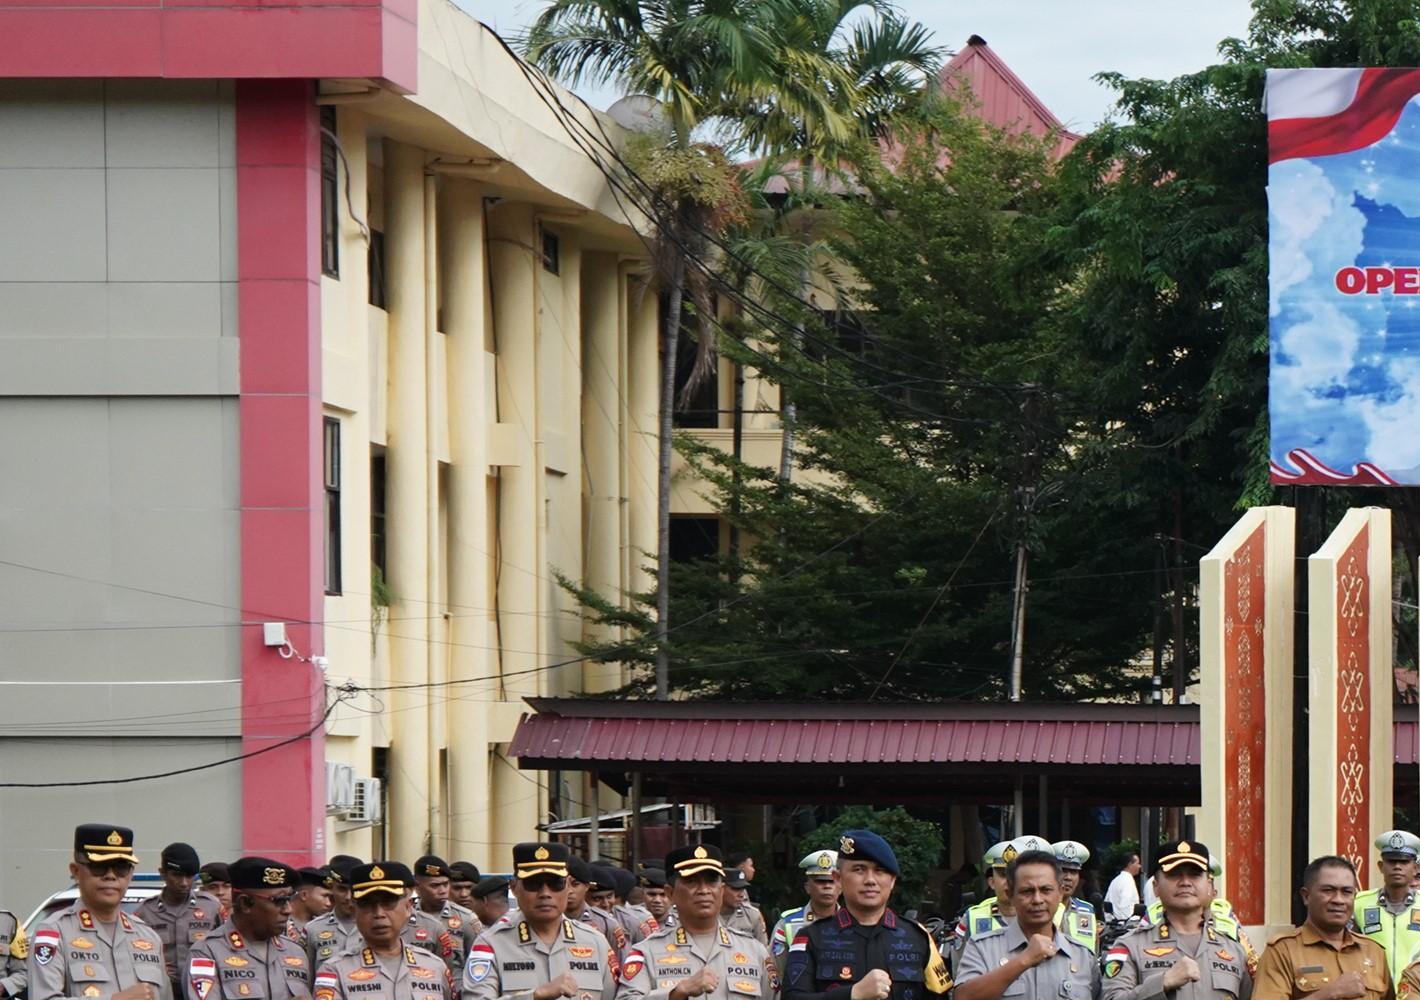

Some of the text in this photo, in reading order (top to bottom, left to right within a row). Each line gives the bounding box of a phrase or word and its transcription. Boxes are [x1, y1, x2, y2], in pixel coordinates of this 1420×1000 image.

[71, 951, 100, 961] OKTO
[133, 953, 160, 963] POLRI
[888, 953, 920, 962] POLRI
[569, 961, 599, 971] POLRI
[1212, 961, 1240, 975] POLRI
[223, 969, 256, 979] NICO
[728, 966, 758, 977] POLRI
[411, 982, 441, 992] POLRI
